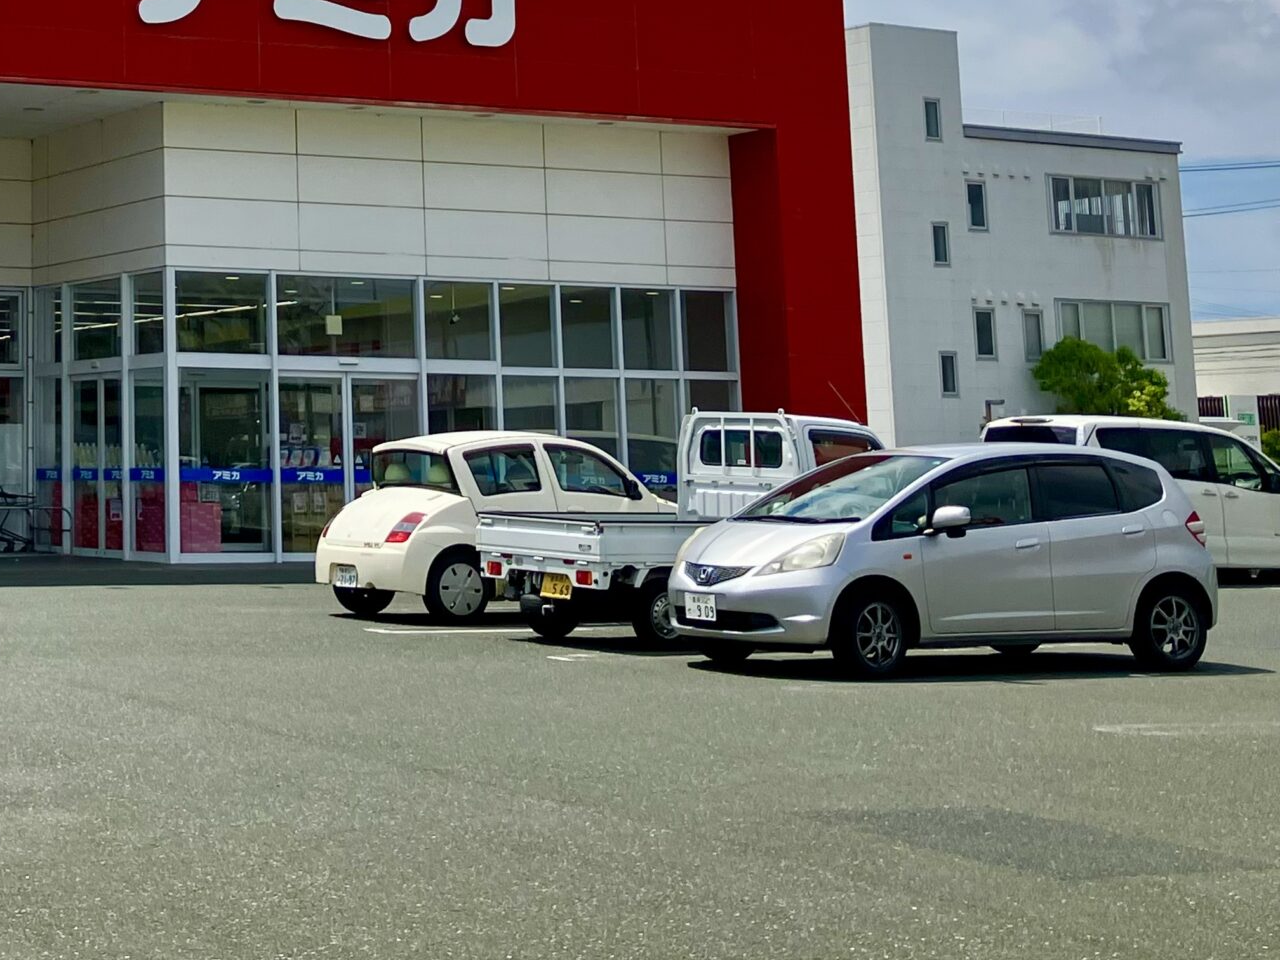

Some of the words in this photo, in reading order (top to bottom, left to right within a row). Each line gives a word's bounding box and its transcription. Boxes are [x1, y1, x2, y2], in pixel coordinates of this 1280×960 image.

[212, 470, 240, 480] アミカ
[296, 471, 324, 481] アミカ
[643, 474, 668, 484] アミカ
